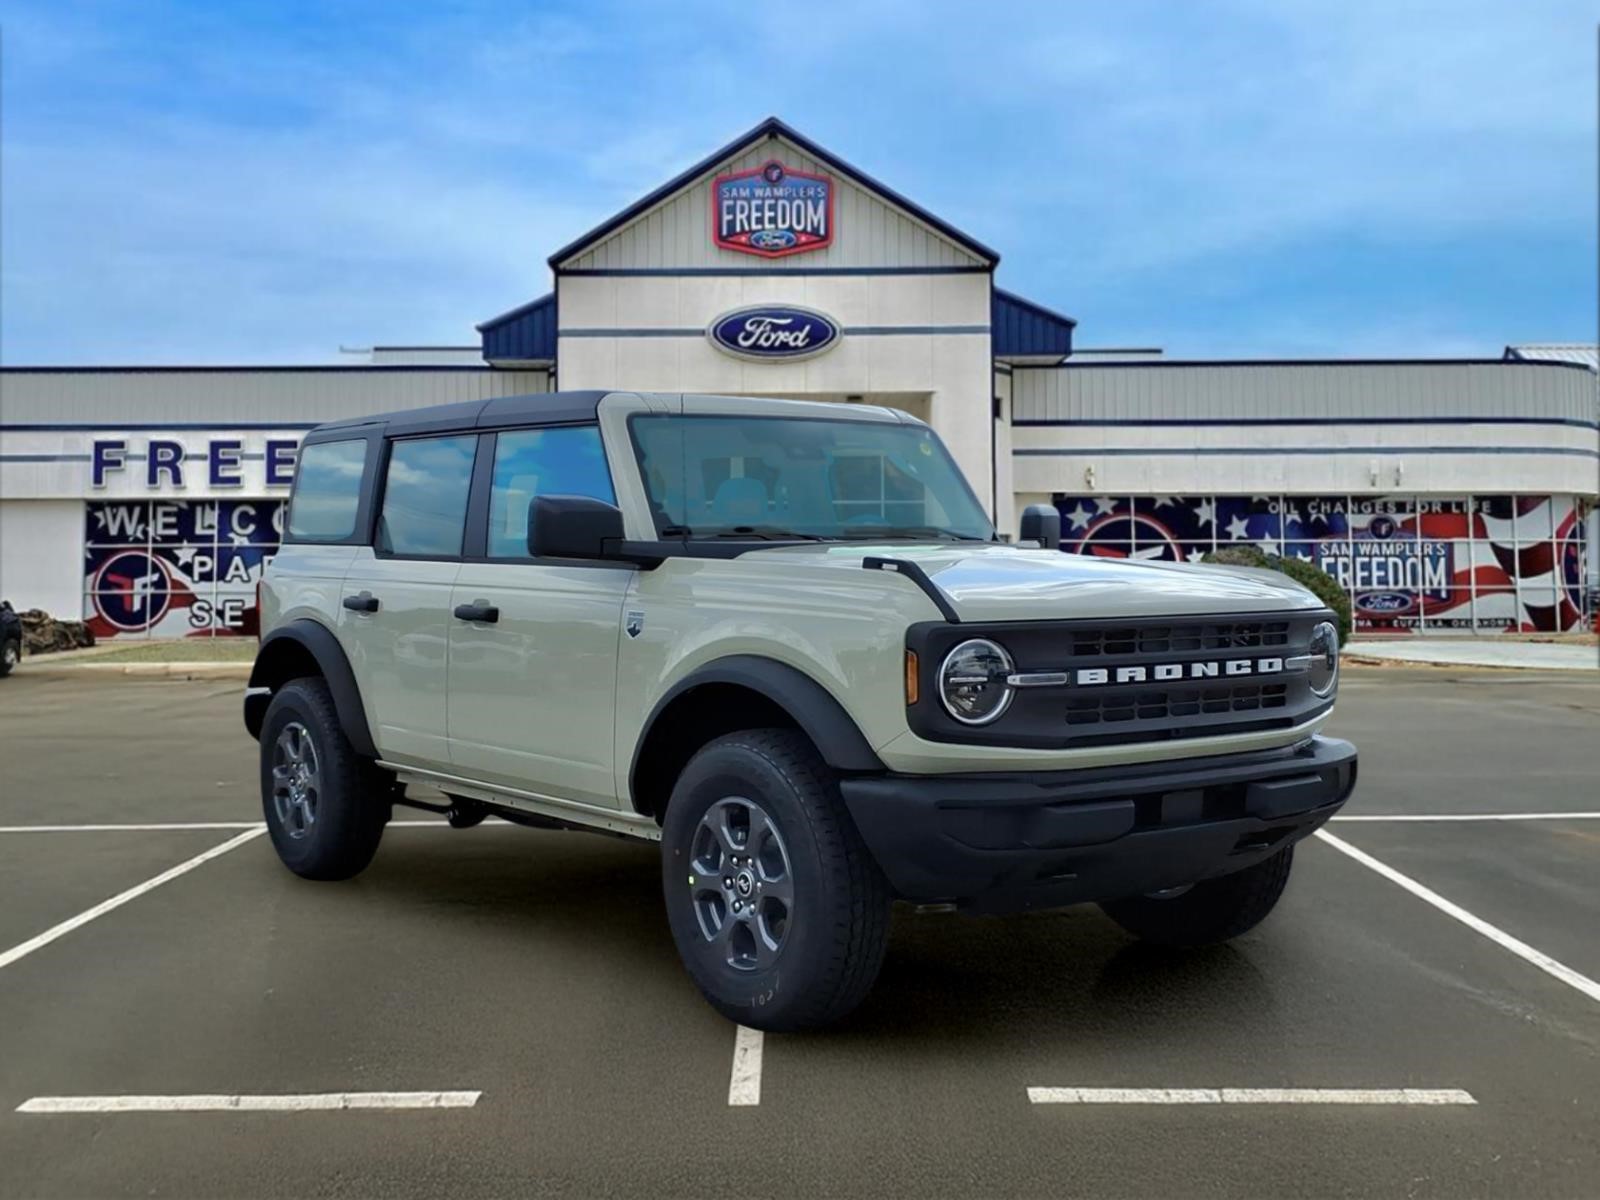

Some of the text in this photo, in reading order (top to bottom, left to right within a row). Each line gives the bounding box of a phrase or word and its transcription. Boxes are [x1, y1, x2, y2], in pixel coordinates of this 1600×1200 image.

[722, 187, 750, 199] SAM
[722, 200, 826, 237] FREEDOM
[737, 316, 812, 348] Ford
[92, 440, 299, 487] FREE
[1267, 500, 1492, 514] OIL CHANGES FOR LIFE
[1321, 556, 1448, 599] FREEDOM
[1365, 595, 1401, 609] Ford
[1076, 657, 1283, 685] BRONCO
